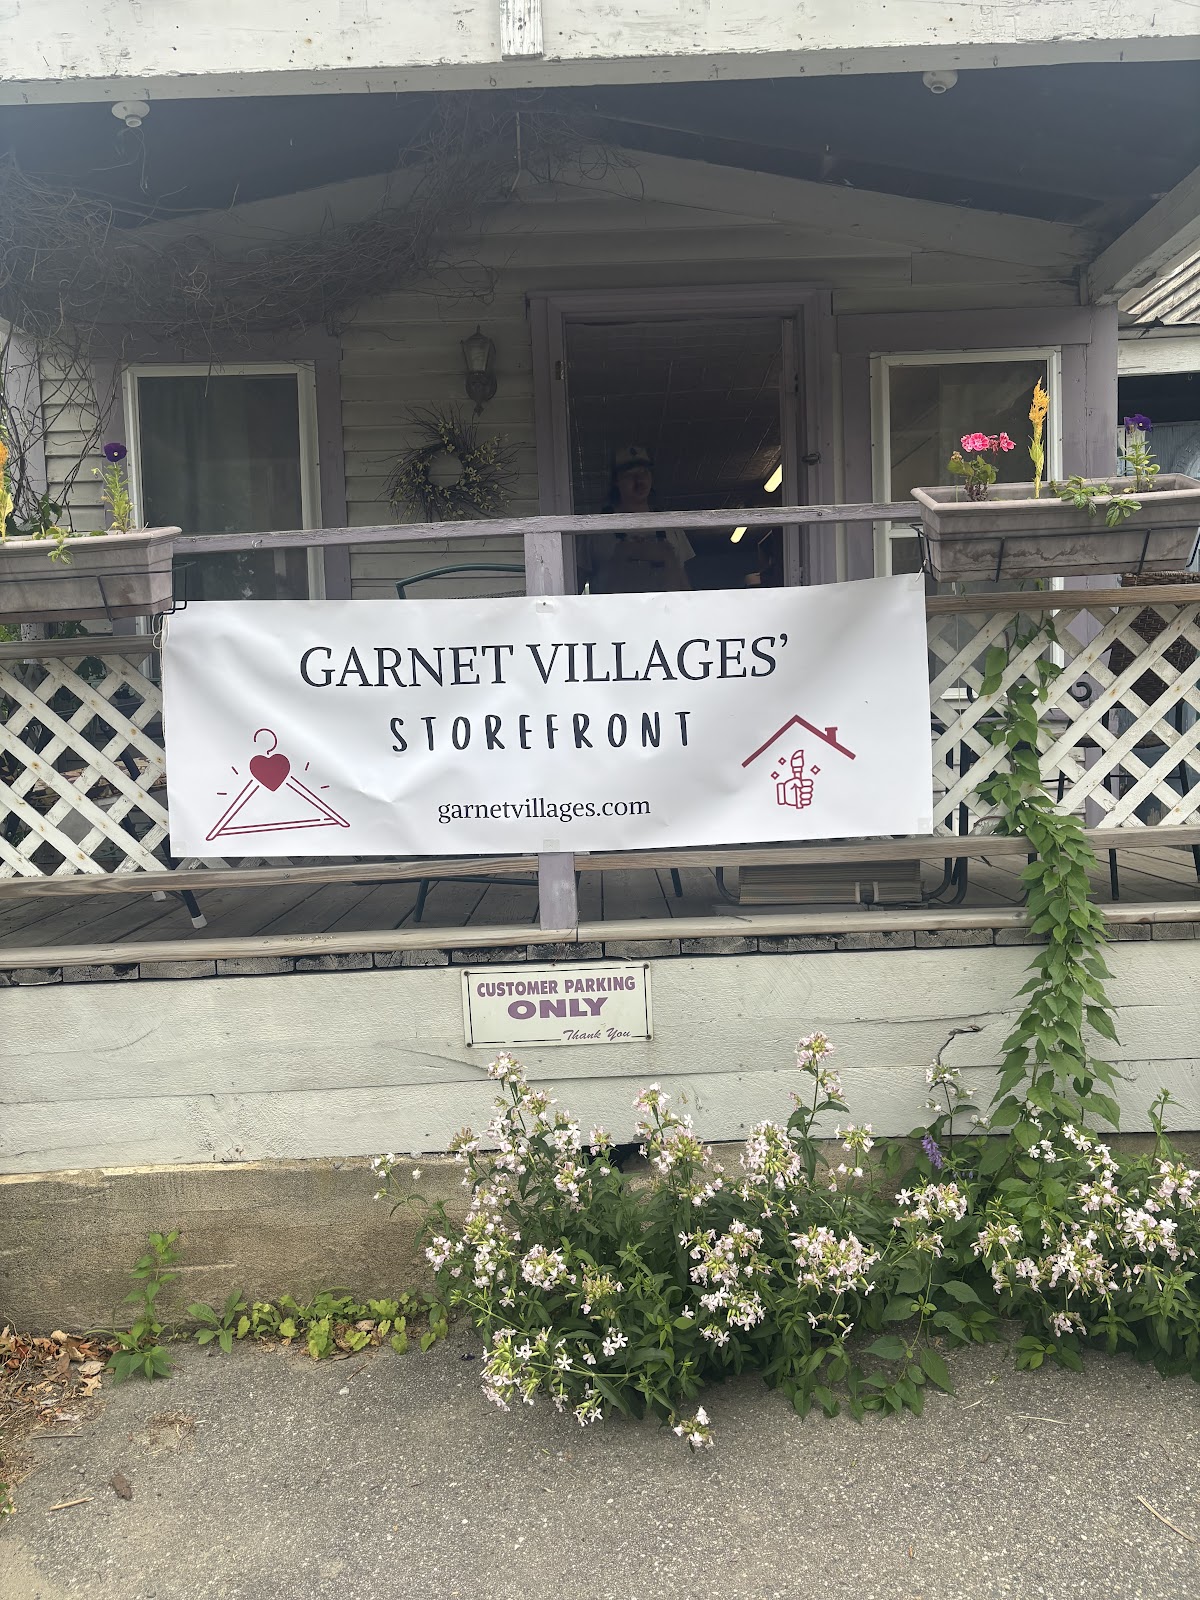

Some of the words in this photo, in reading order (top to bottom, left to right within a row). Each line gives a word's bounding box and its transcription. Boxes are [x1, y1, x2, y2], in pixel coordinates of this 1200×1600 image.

[300, 645, 513, 687] GARNET
[526, 633, 789, 685] VILLAGES’
[390, 712, 691, 753] STOREFRONT
[438, 797, 651, 824] garnetvillages.com
[477, 980, 558, 997] CUSTOMER
[565, 976, 636, 993] PARKING
[507, 997, 608, 1020] ONLY
[563, 1029, 602, 1041] Thank
[605, 1027, 631, 1040] You
